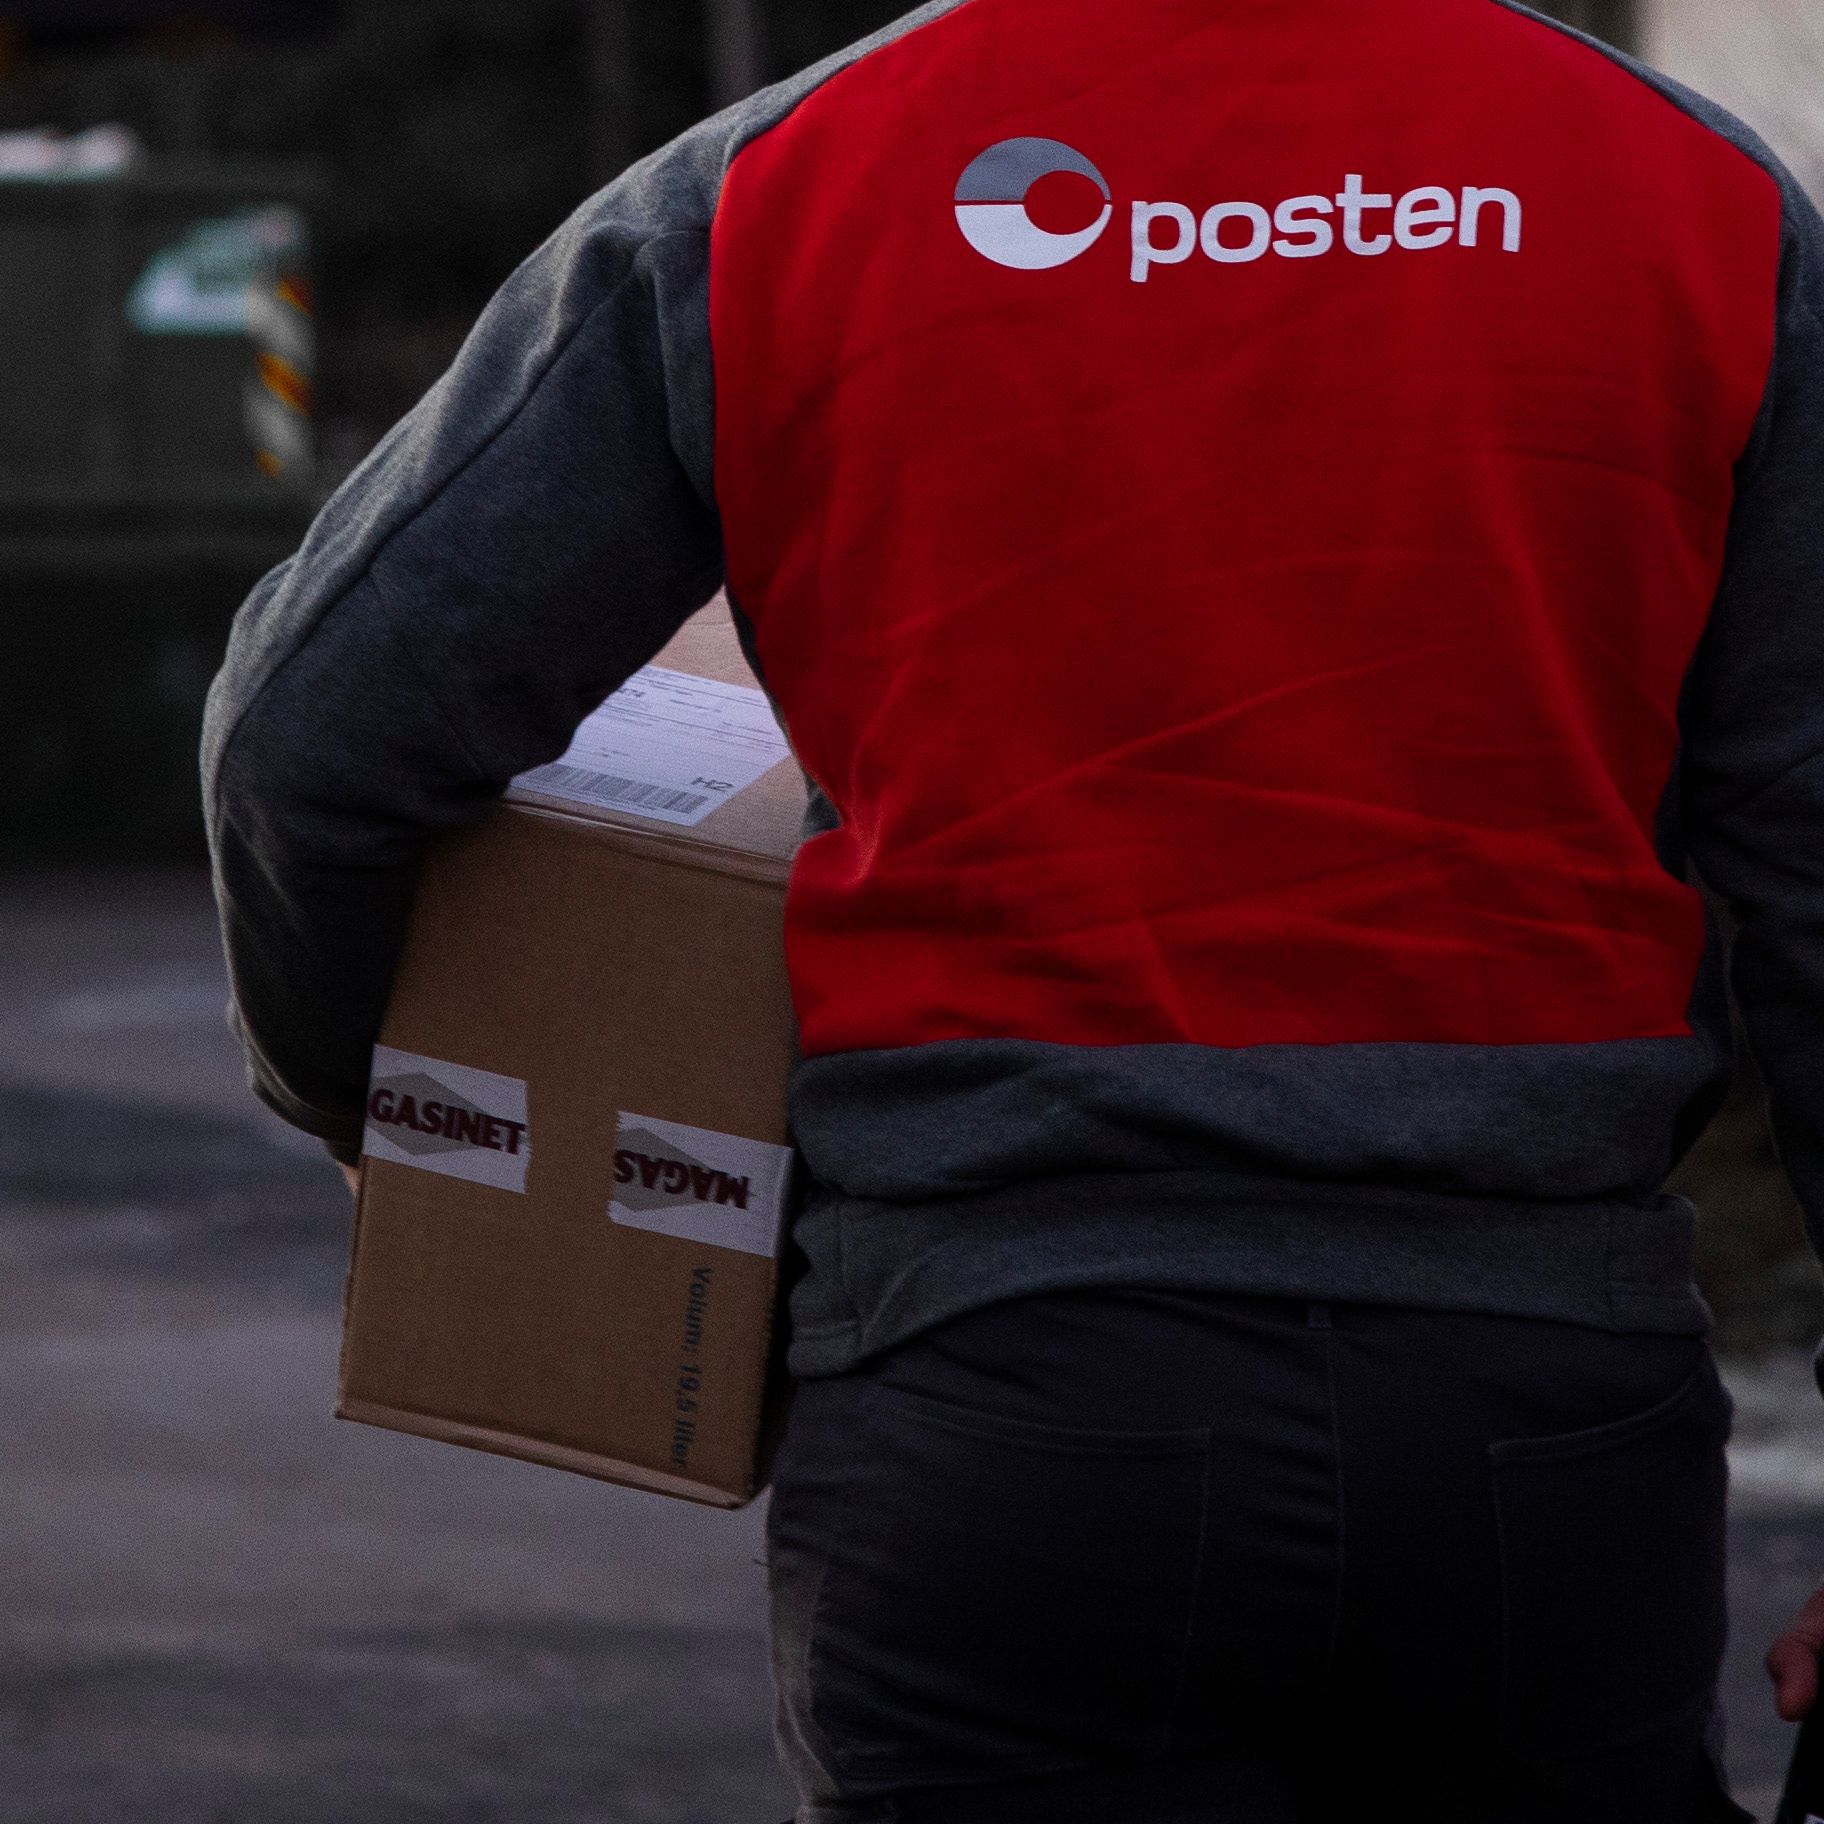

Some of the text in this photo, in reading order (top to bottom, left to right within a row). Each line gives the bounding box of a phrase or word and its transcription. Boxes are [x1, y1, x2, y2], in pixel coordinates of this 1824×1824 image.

[1131, 173, 1520, 283] posten
[690, 776, 734, 793] H2
[368, 1088, 526, 1155] GASINET
[613, 1149, 749, 1210] MAGAS
